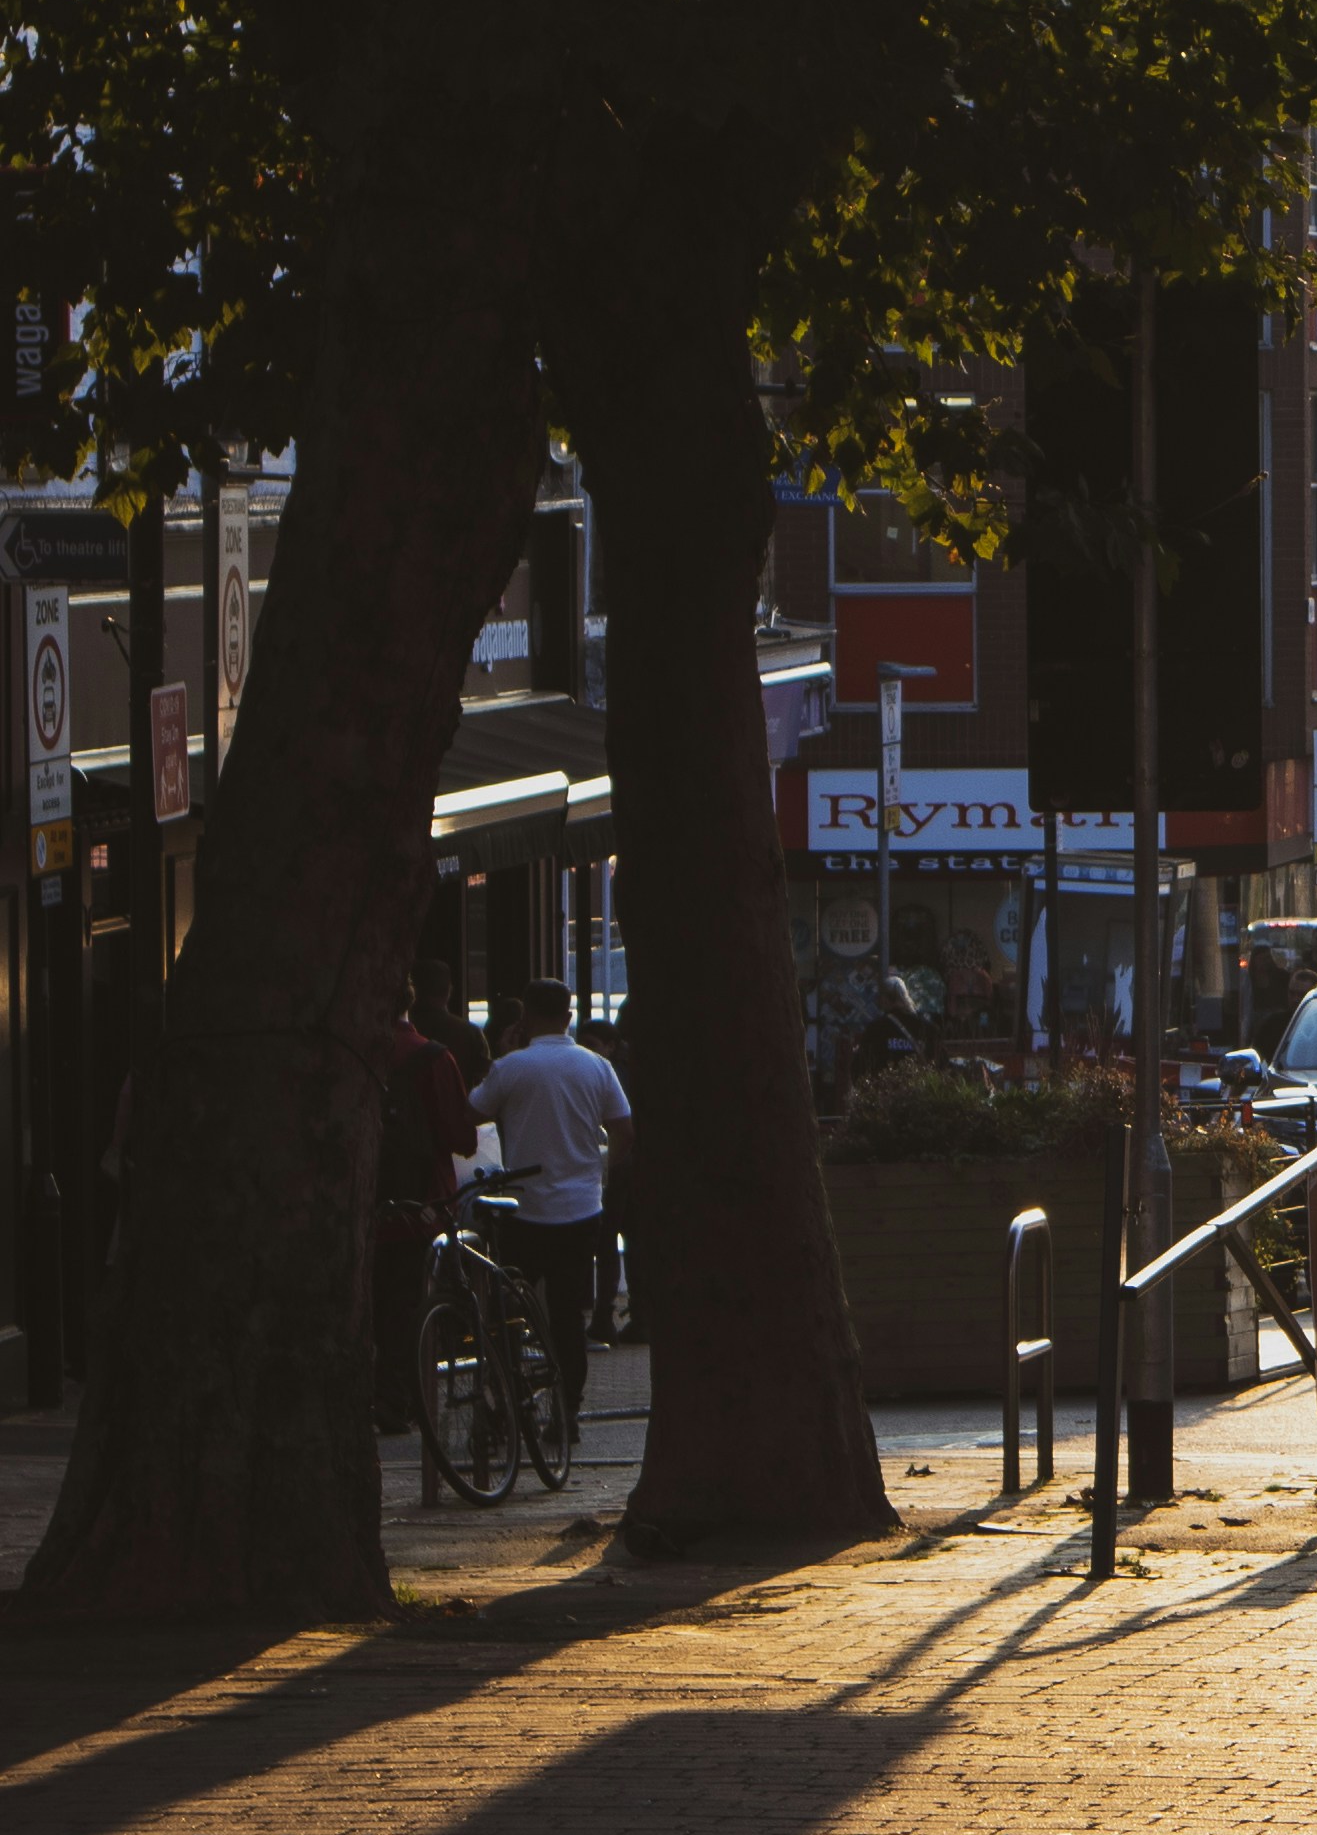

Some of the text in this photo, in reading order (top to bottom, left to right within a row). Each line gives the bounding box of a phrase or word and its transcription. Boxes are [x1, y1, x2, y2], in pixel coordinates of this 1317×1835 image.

[15, 294, 50, 398] waga
[781, 491, 840, 501] EXCANG
[39, 537, 128, 556] To theatre lift
[36, 598, 59, 625] ZONE
[818, 792, 1135, 837] Rym
[821, 854, 1030, 872] the stat
[829, 929, 870, 943] FREE
[887, 1037, 915, 1051] SECU
